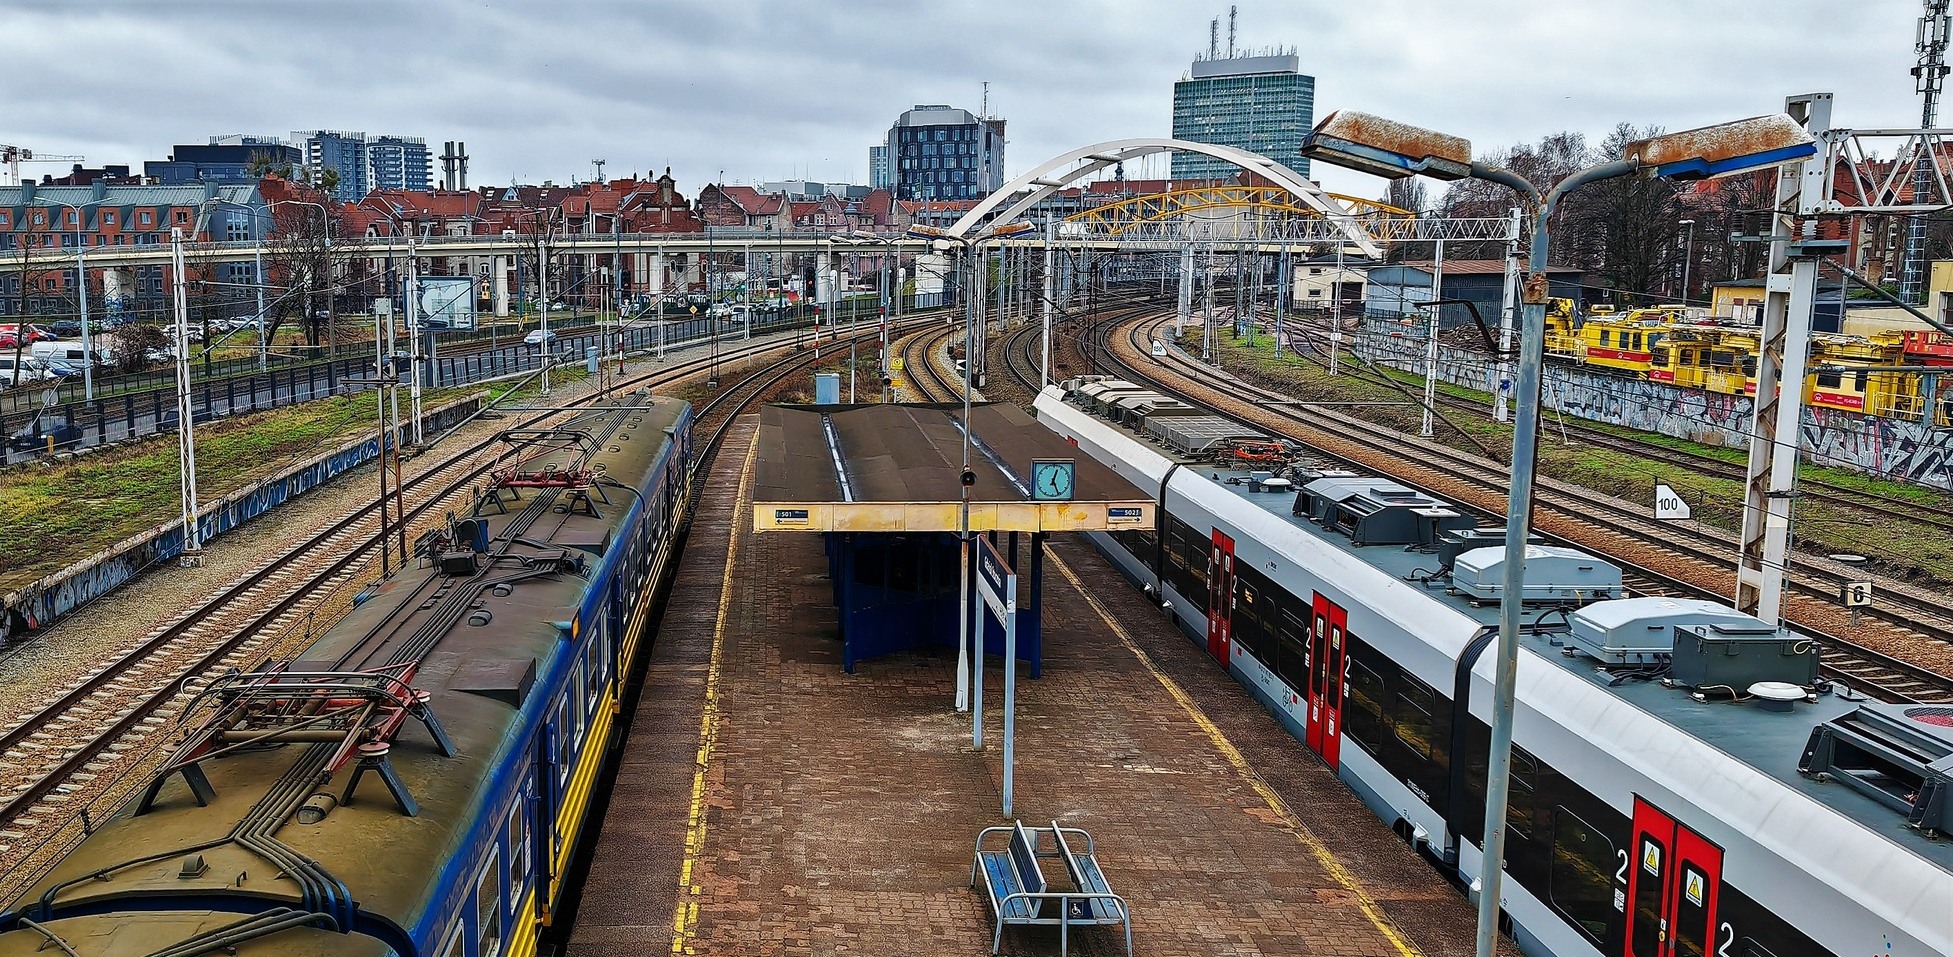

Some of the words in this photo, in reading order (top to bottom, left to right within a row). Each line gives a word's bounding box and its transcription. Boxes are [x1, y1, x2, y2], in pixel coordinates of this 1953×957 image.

[1658, 498, 1678, 511] 100
[1207, 557, 1212, 575] 2
[1232, 574, 1238, 594] 2
[1853, 585, 1865, 603] 6
[1305, 626, 1312, 649] 2
[1344, 654, 1351, 679] 2
[1615, 848, 1629, 885] 2
[1718, 921, 1734, 957] 2
